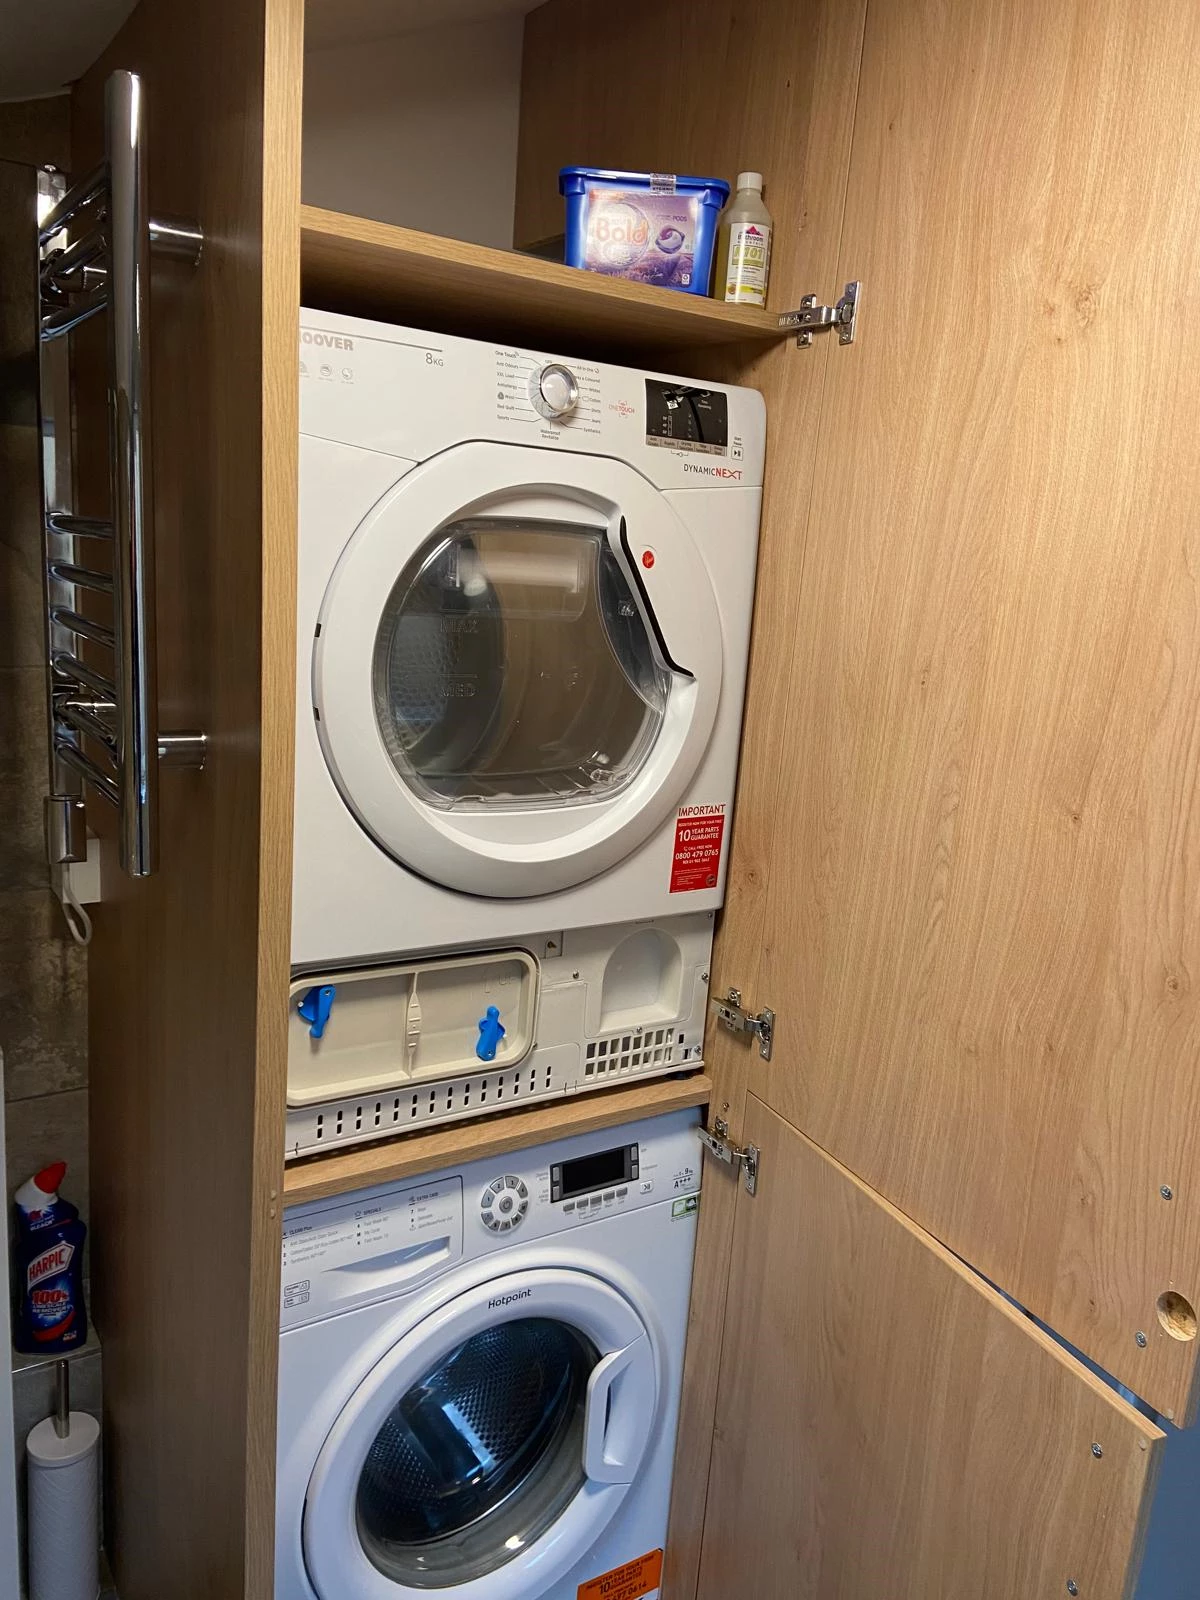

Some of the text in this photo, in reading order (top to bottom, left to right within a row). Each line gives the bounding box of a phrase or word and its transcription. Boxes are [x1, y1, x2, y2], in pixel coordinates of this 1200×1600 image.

[596, 217, 649, 246] Bold
[299, 331, 354, 352] OOVER
[425, 352, 444, 367] 8KG
[678, 804, 726, 817] IMPORTANT
[678, 829, 691, 842] 10
[690, 832, 719, 841] GUARANTEE
[704, 826, 720, 834] PARTS
[28, 1249, 65, 1280] HARPIC
[487, 1288, 532, 1310] Hotpoint
[600, 1581, 610, 1594] 10
